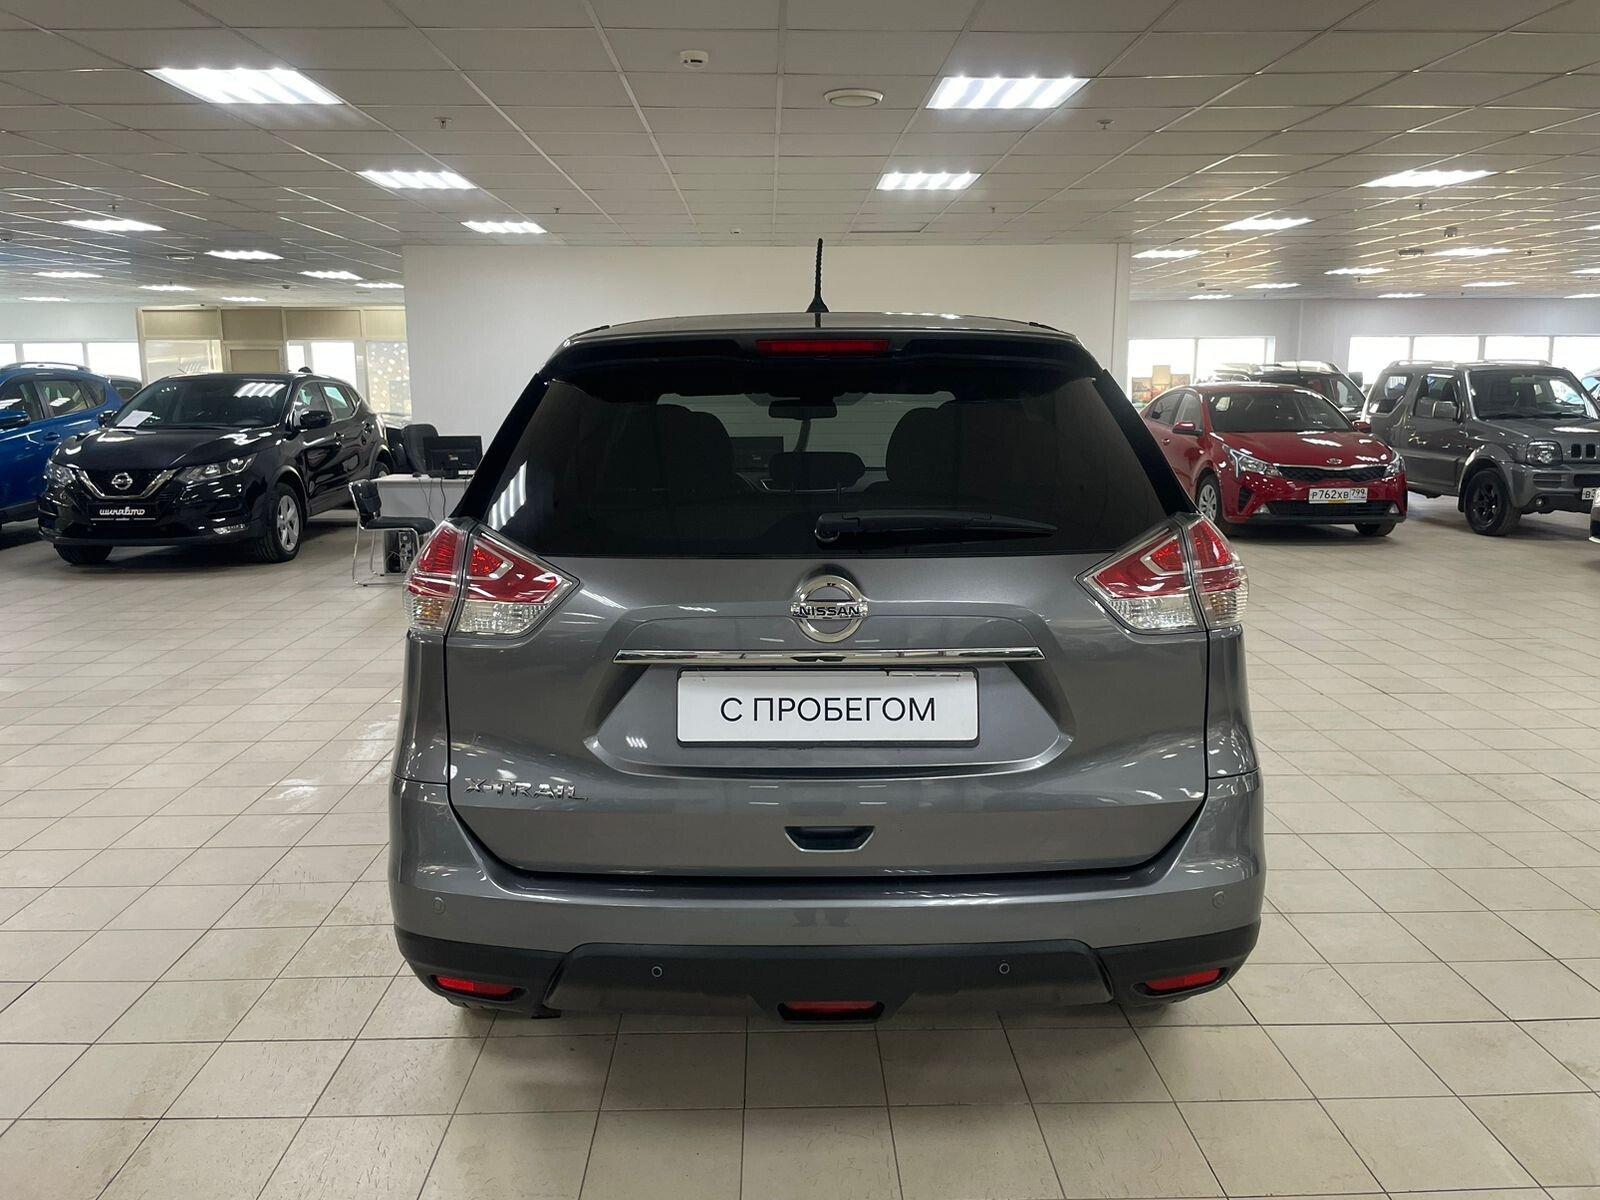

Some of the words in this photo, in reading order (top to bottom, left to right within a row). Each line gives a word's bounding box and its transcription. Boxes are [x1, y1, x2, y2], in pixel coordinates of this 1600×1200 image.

[1311, 489, 1349, 499] Р762ХВ
[1351, 488, 1366, 497] 799
[799, 606, 860, 616] NISSAN
[720, 696, 743, 722] С
[752, 696, 936, 722] ПРОБЕГОМ
[464, 777, 588, 801] X-TRAIL
